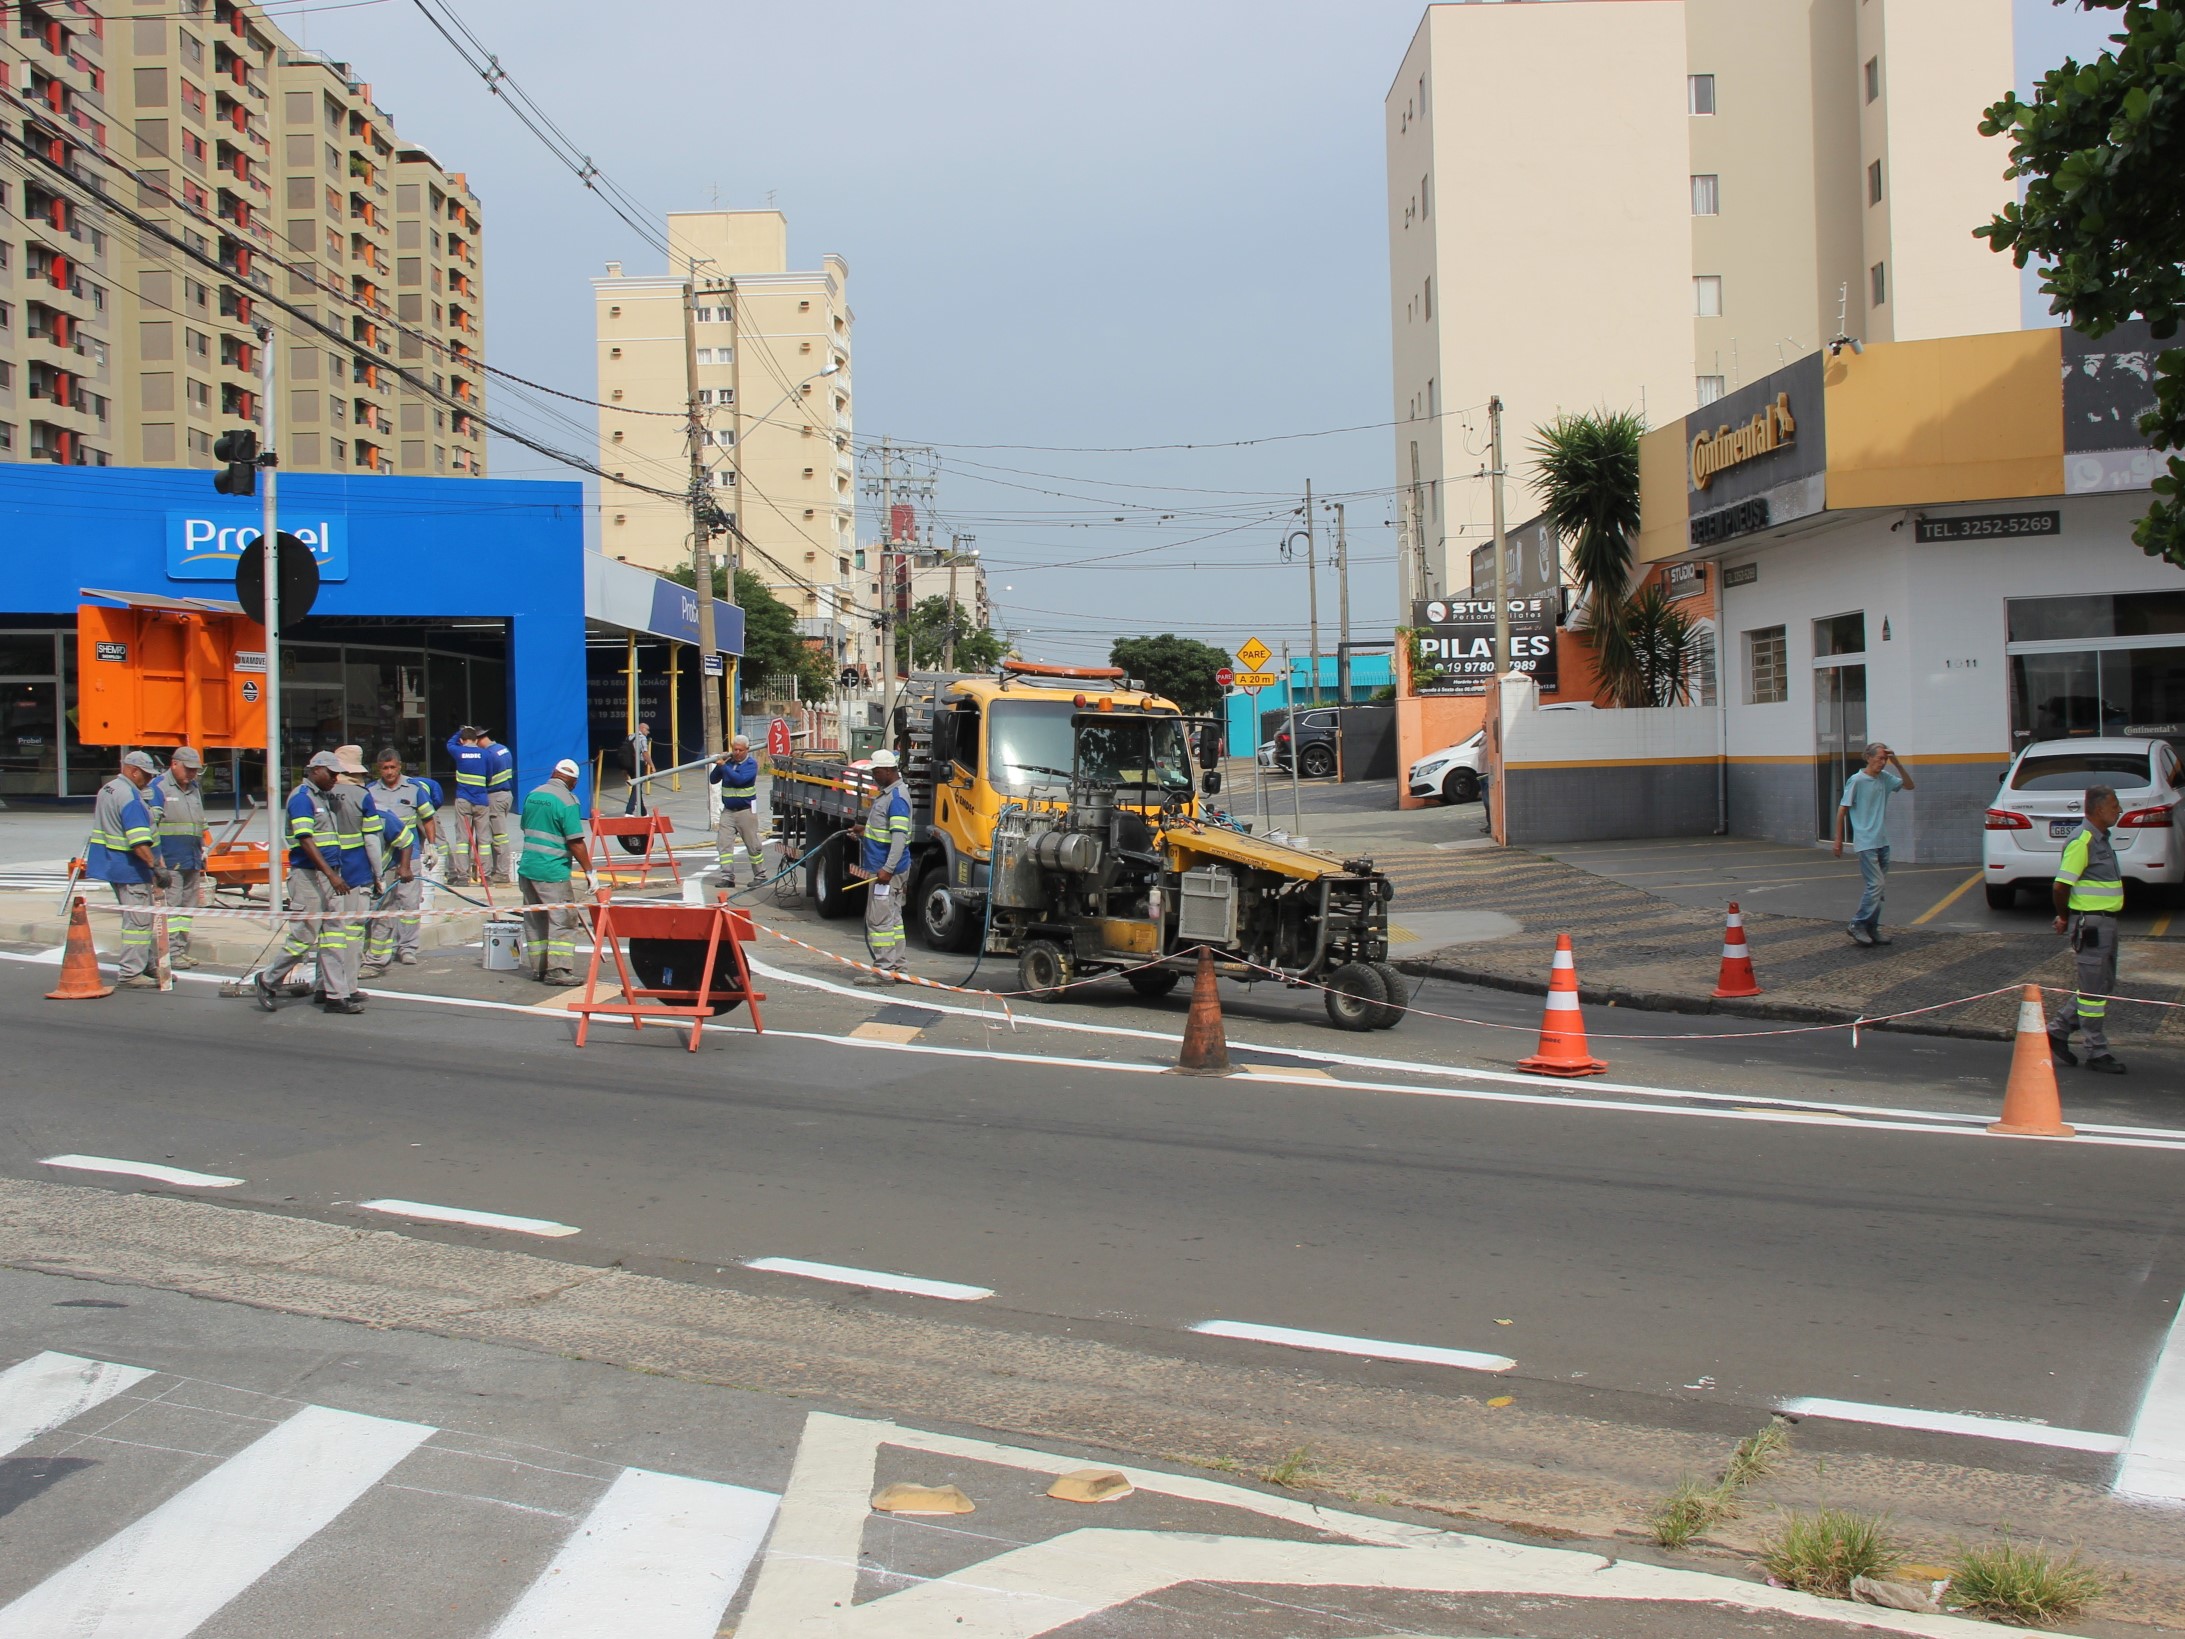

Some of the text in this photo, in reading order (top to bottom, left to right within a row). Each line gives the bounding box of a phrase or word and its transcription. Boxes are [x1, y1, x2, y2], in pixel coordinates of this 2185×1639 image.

[1692, 404, 1778, 490] Continental
[1923, 517, 2053, 538] TEL. 3252-5269
[186, 519, 329, 553] Proel
[1671, 563, 1695, 583] STUDIO
[1452, 600, 1542, 614] STUIO E
[1509, 612, 1542, 621] ilates
[1243, 650, 1266, 659] PARE
[1447, 662, 1461, 673] 19
[1240, 675, 1247, 683] A
[1249, 675, 1260, 683] 20
[773, 722, 784, 754] PAR
[2123, 725, 2170, 736] Continental
[959, 796, 975, 815] EMDEC
